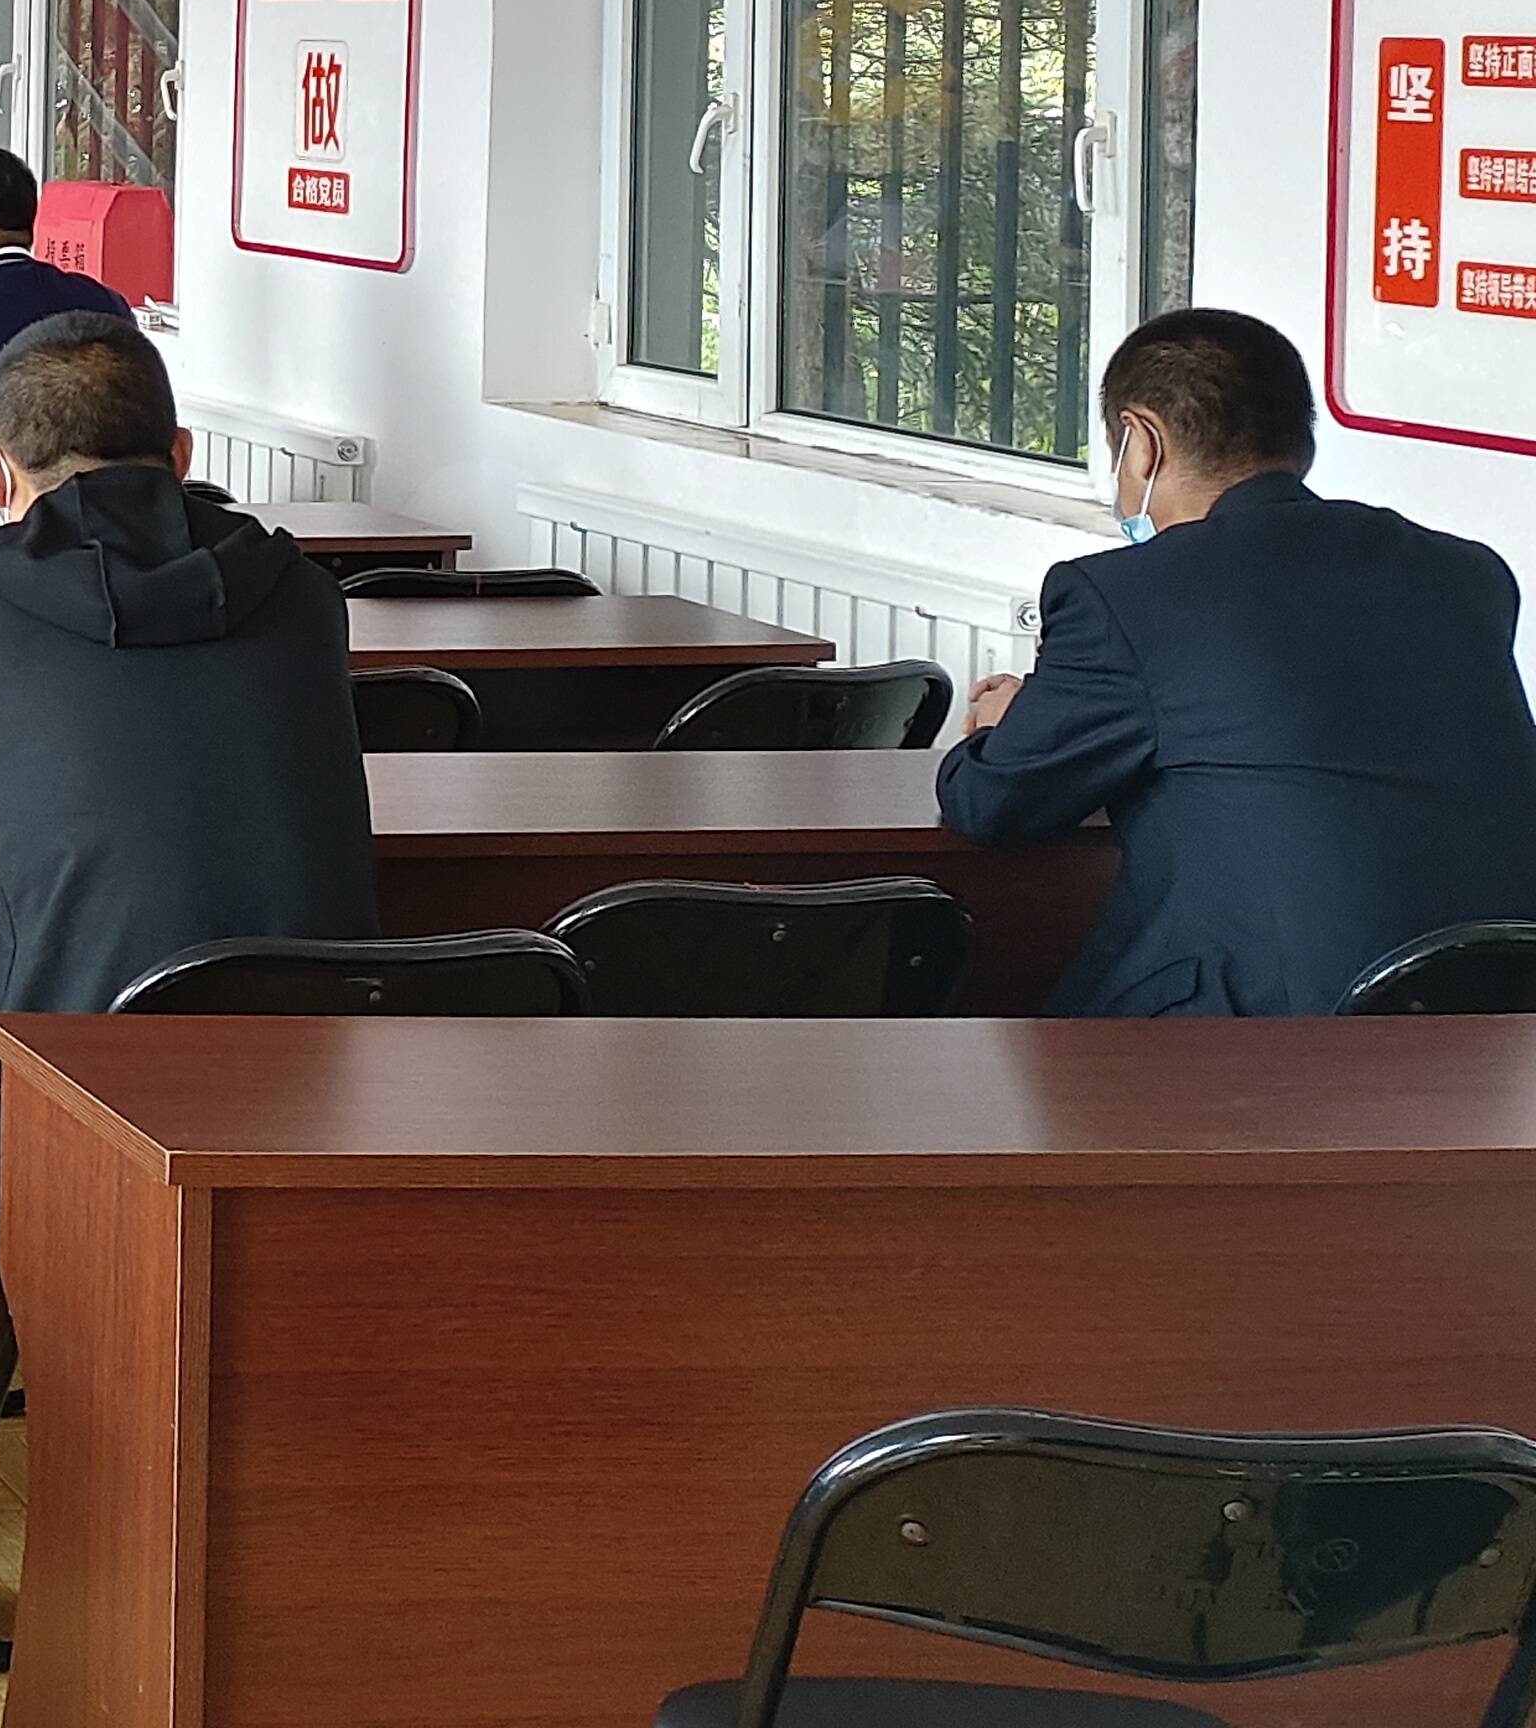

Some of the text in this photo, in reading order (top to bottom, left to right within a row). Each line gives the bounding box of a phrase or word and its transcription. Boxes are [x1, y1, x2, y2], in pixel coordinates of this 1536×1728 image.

[1468, 42, 1536, 81] 坚持正面
[299, 51, 341, 152] 做
[291, 173, 346, 208] 合格党员
